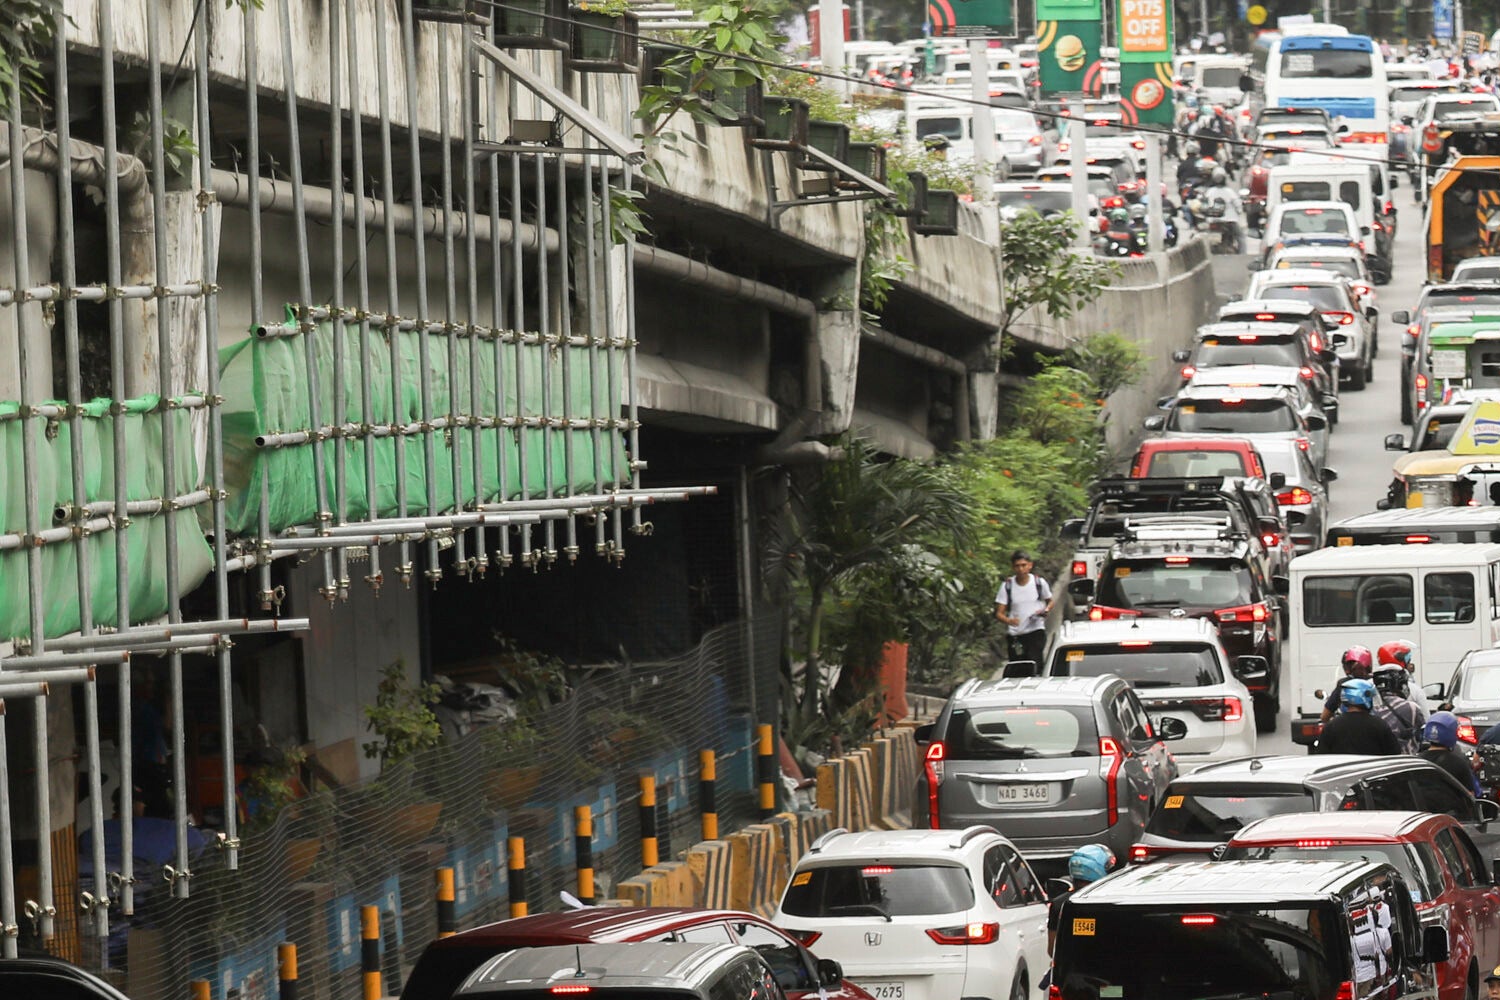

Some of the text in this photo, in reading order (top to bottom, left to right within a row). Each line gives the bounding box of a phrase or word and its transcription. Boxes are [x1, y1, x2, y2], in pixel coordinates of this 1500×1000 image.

[1127, 19, 1160, 35] OFF
[1023, 786, 1047, 798] 3468
[875, 986, 902, 998] 7675
